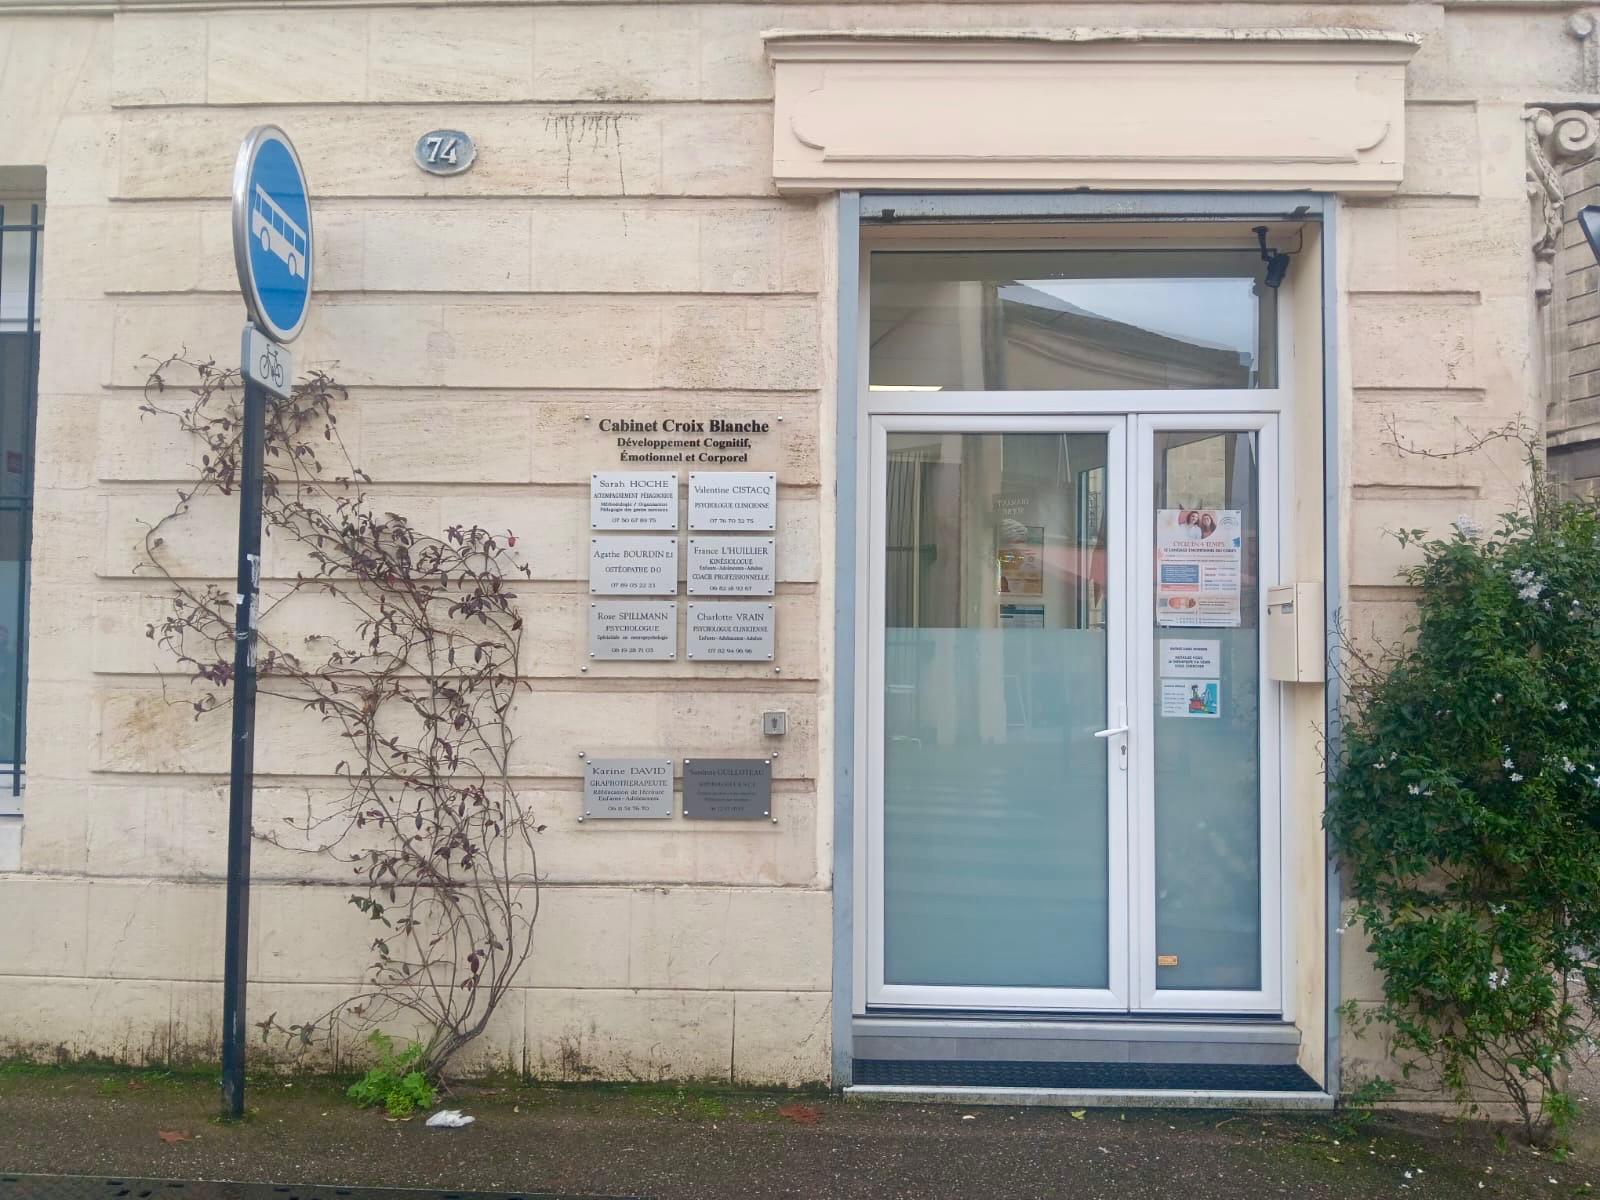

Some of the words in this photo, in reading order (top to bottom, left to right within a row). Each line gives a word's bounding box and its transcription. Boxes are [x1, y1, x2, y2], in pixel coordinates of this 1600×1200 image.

[427, 137, 457, 164] 74
[599, 418, 658, 432] Cabinet
[662, 419, 704, 433] Croix
[710, 420, 769, 433] Blanche
[617, 437, 700, 449] Développement
[704, 438, 751, 450] Cognitif,
[620, 450, 682, 462] Émotionnel
[686, 454, 695, 462] et
[698, 452, 748, 464] Corporel
[694, 486, 729, 494] Valentine
[732, 486, 770, 495] CISTACQ
[593, 550, 620, 560] Agathe
[694, 547, 719, 555] France
[722, 547, 768, 555] L'HUILLIER
